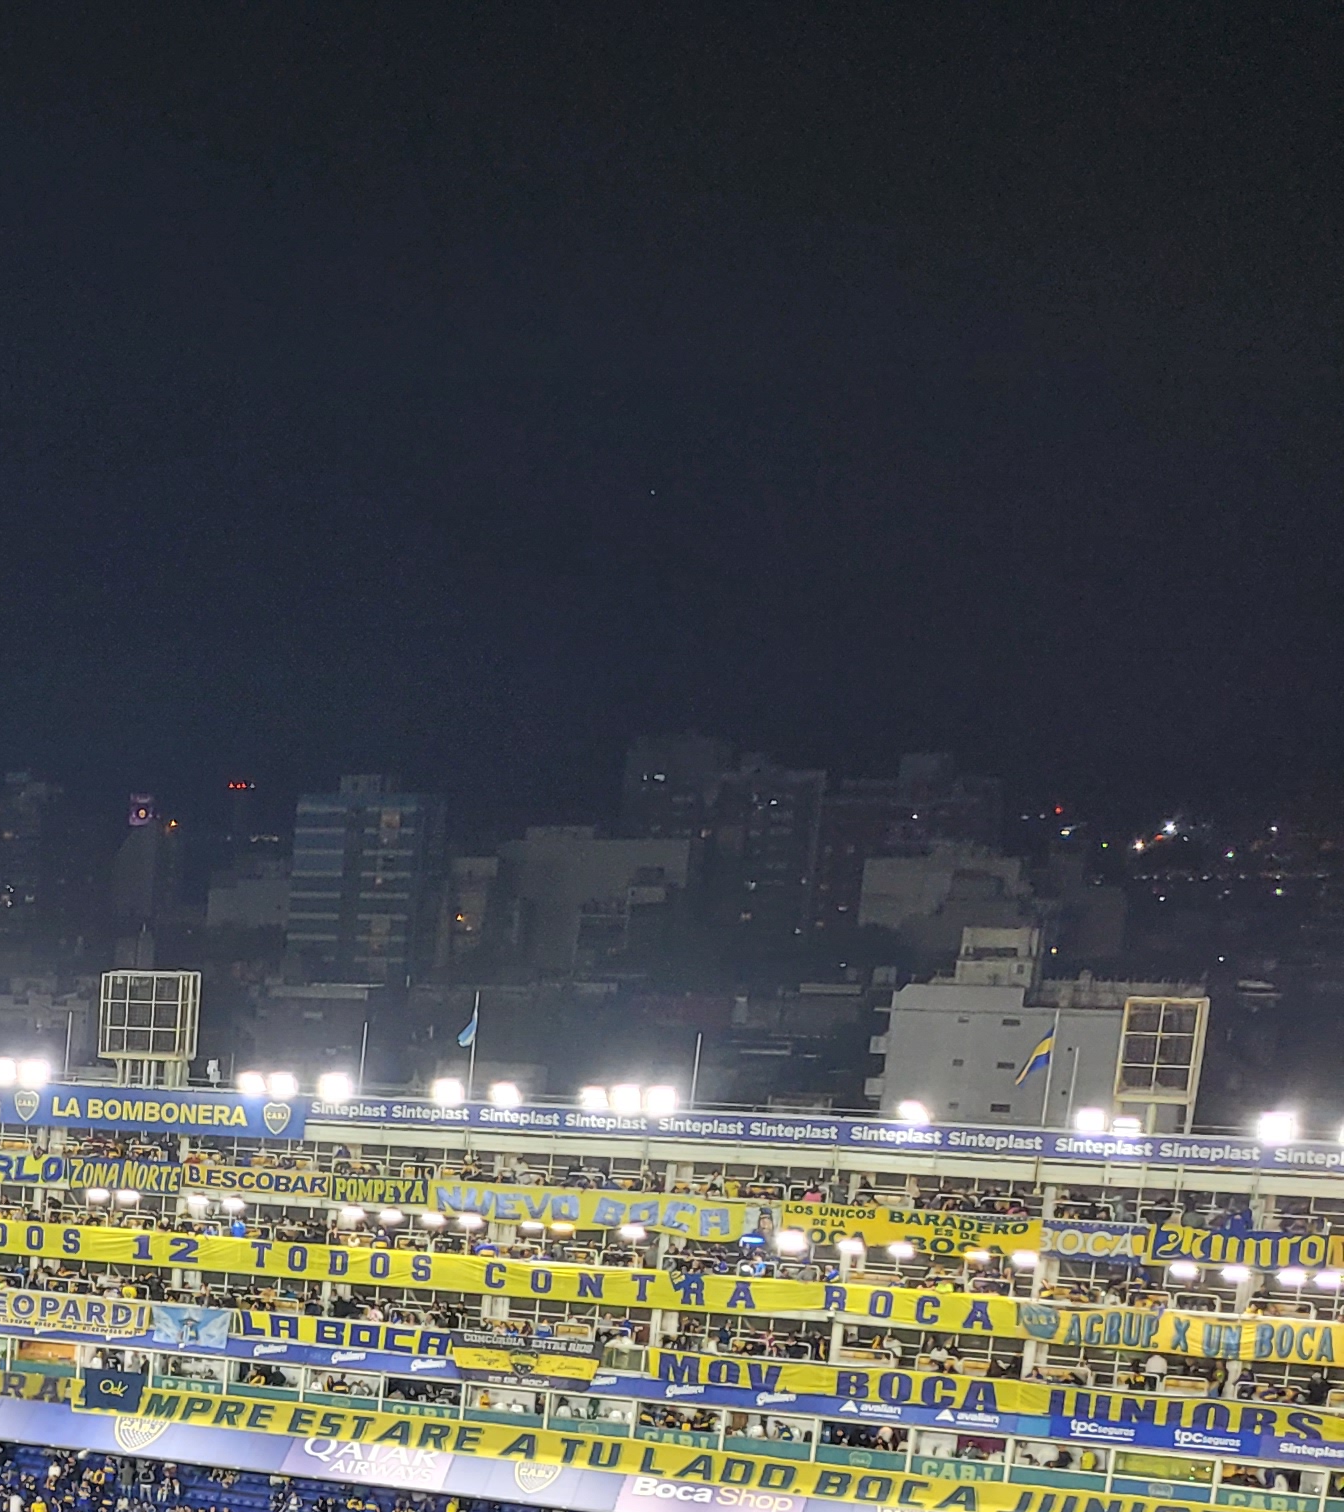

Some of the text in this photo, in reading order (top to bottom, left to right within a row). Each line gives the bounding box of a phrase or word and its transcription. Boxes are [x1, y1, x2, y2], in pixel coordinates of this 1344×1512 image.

[52, 1097, 248, 1127] LA BOMBONERA
[71, 1159, 181, 1192] ZONA NORTE
[335, 1178, 426, 1203] POMPEYA
[435, 1185, 730, 1236] NUEVO BOCA
[785, 1204, 813, 1215] LOS
[889, 1210, 1029, 1235] BARADERO
[960, 1231, 981, 1242] DE
[1158, 1223, 1327, 1268] Munro
[133, 1234, 199, 1263] 12
[251, 1241, 432, 1281] TODOS
[485, 1261, 756, 1310] CONTRA
[824, 1284, 994, 1331] BOCA
[243, 1312, 452, 1356] LA BOCA
[464, 1333, 525, 1347] CONCORDIA
[1171, 1316, 1335, 1363] X UN BOCA
[659, 1352, 1324, 1442] MOV BOCA JUNIORS
[288, 1404, 485, 1451] ESTARE
[500, 1435, 538, 1460] A
[561, 1437, 622, 1468] TU
[304, 1435, 439, 1468] QATAR
[329, 1458, 432, 1482] AIRWAYS
[632, 1476, 713, 1503] Boca
